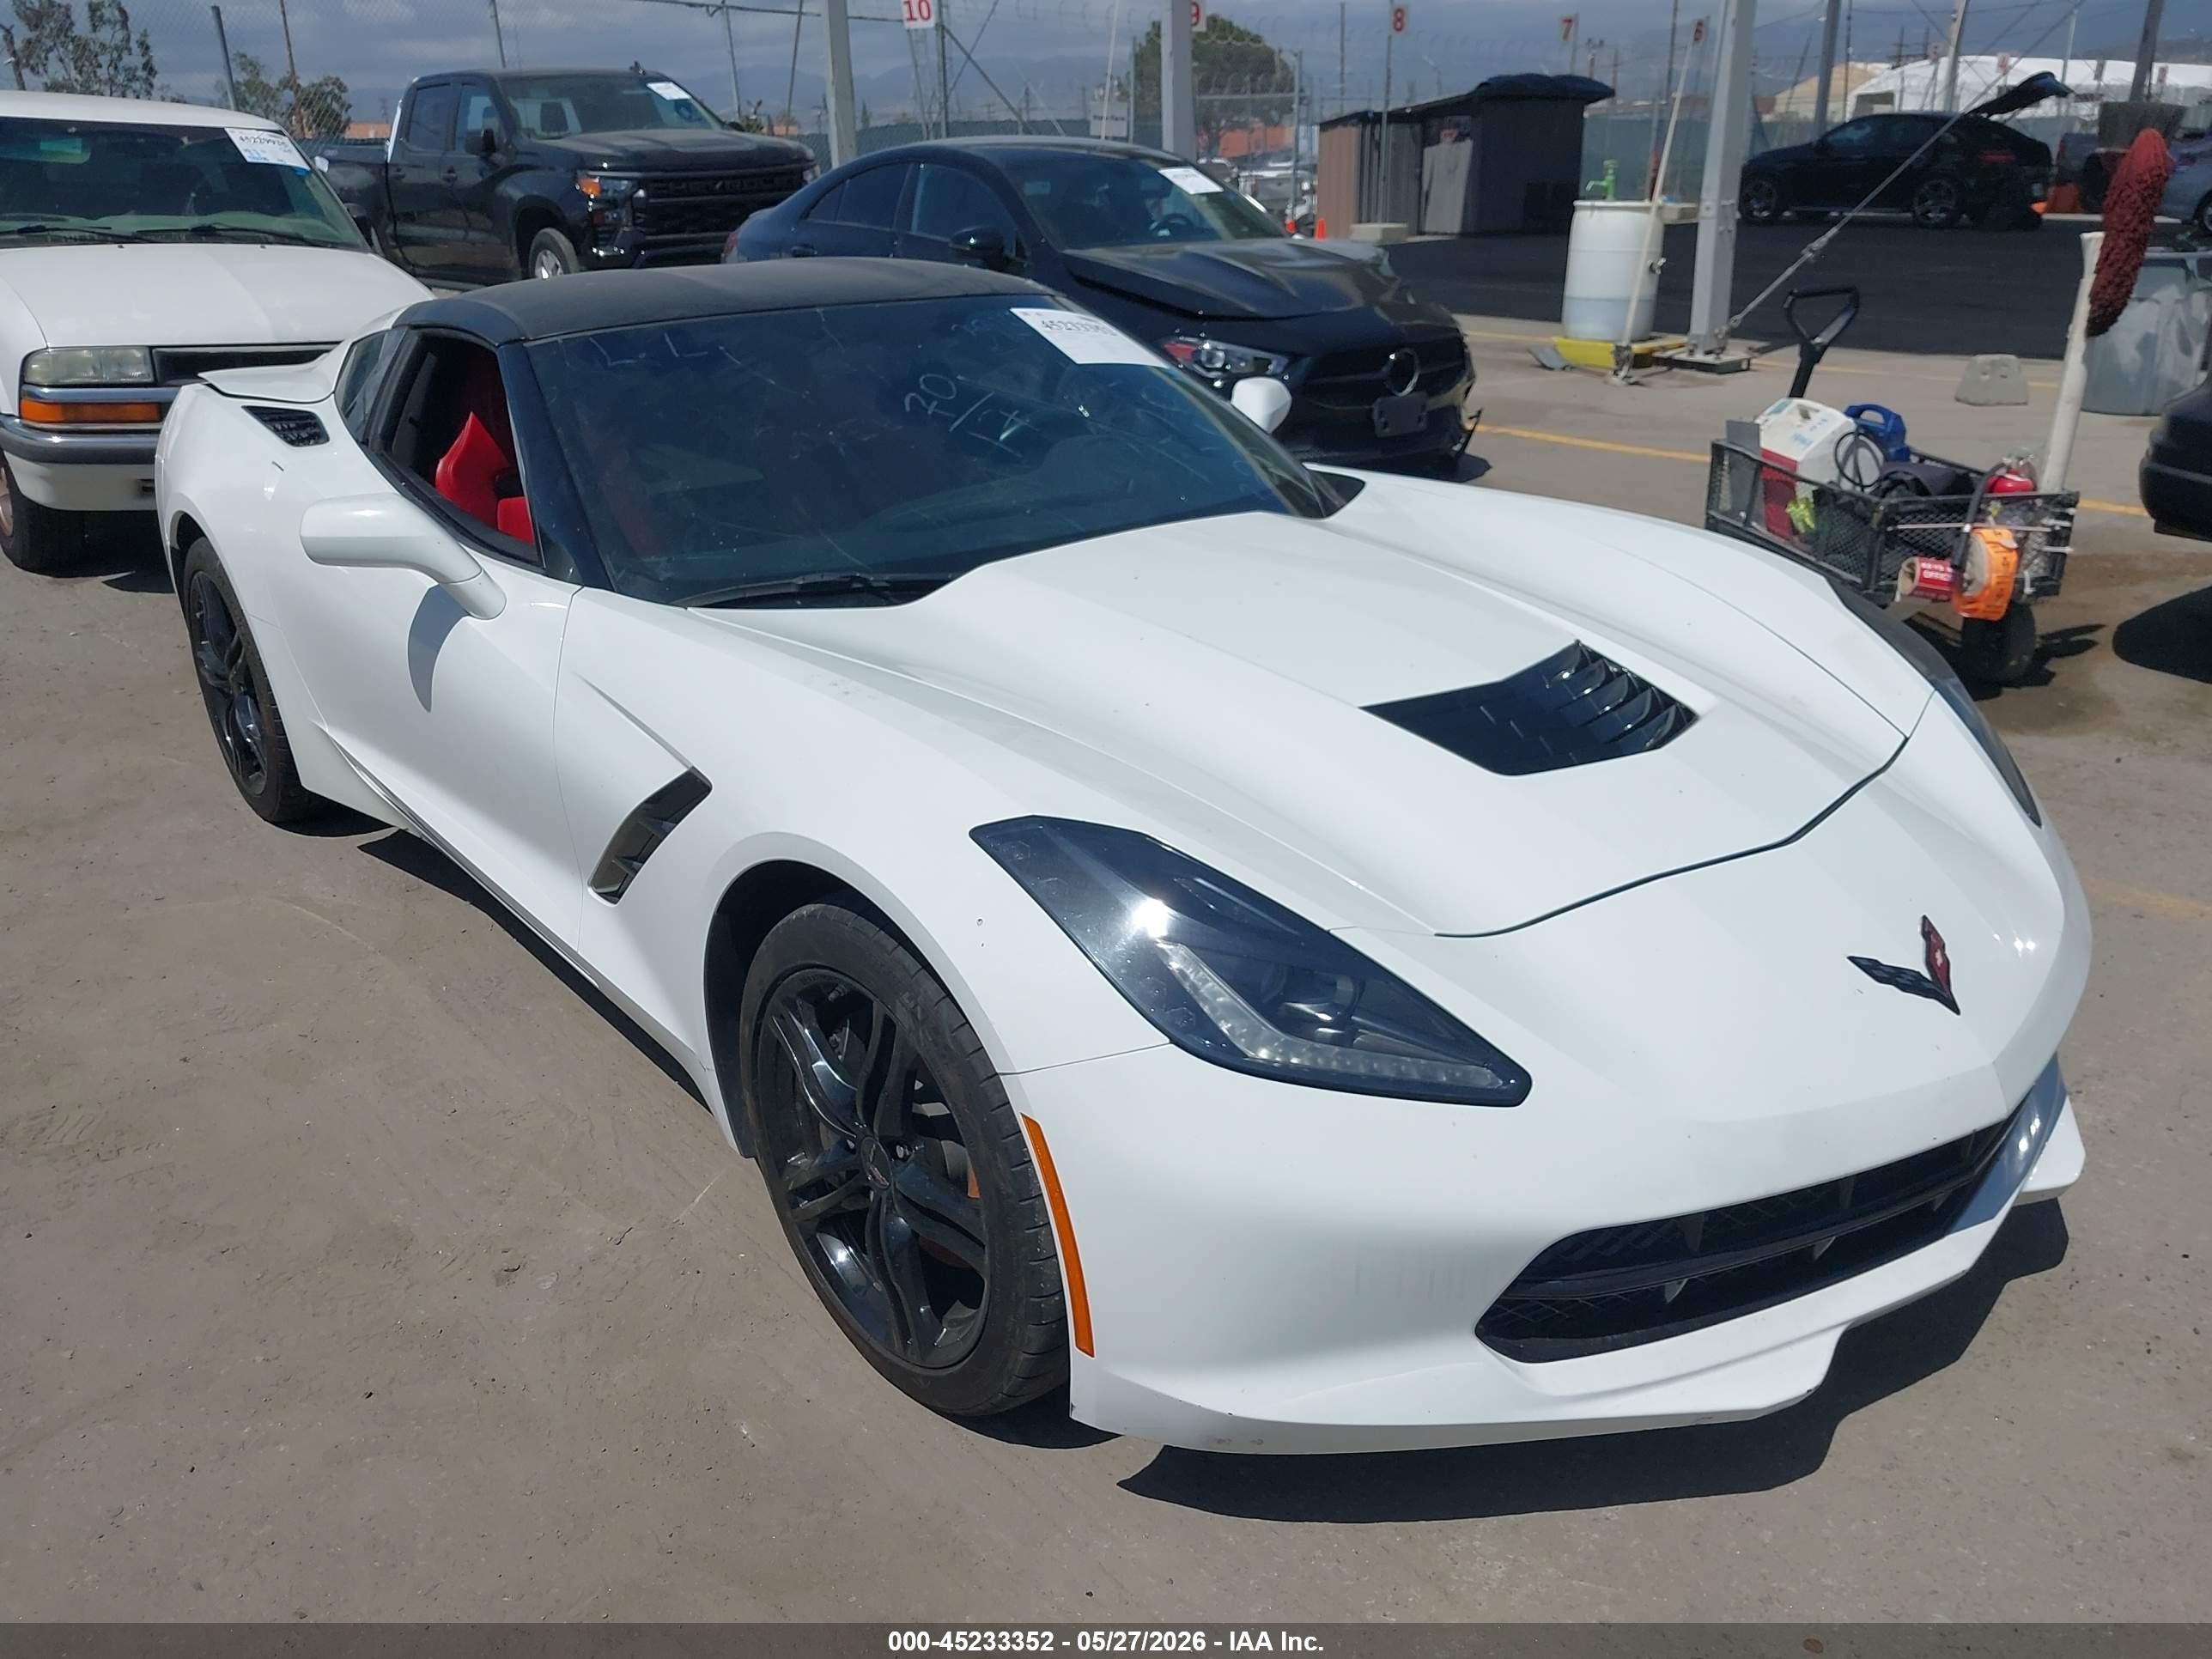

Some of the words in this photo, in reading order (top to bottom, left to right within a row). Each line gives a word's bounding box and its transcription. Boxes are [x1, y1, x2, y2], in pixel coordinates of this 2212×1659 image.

[903, 0, 931, 21] 10
[1394, 8, 1405, 32] 8
[1562, 17, 1573, 41] 7
